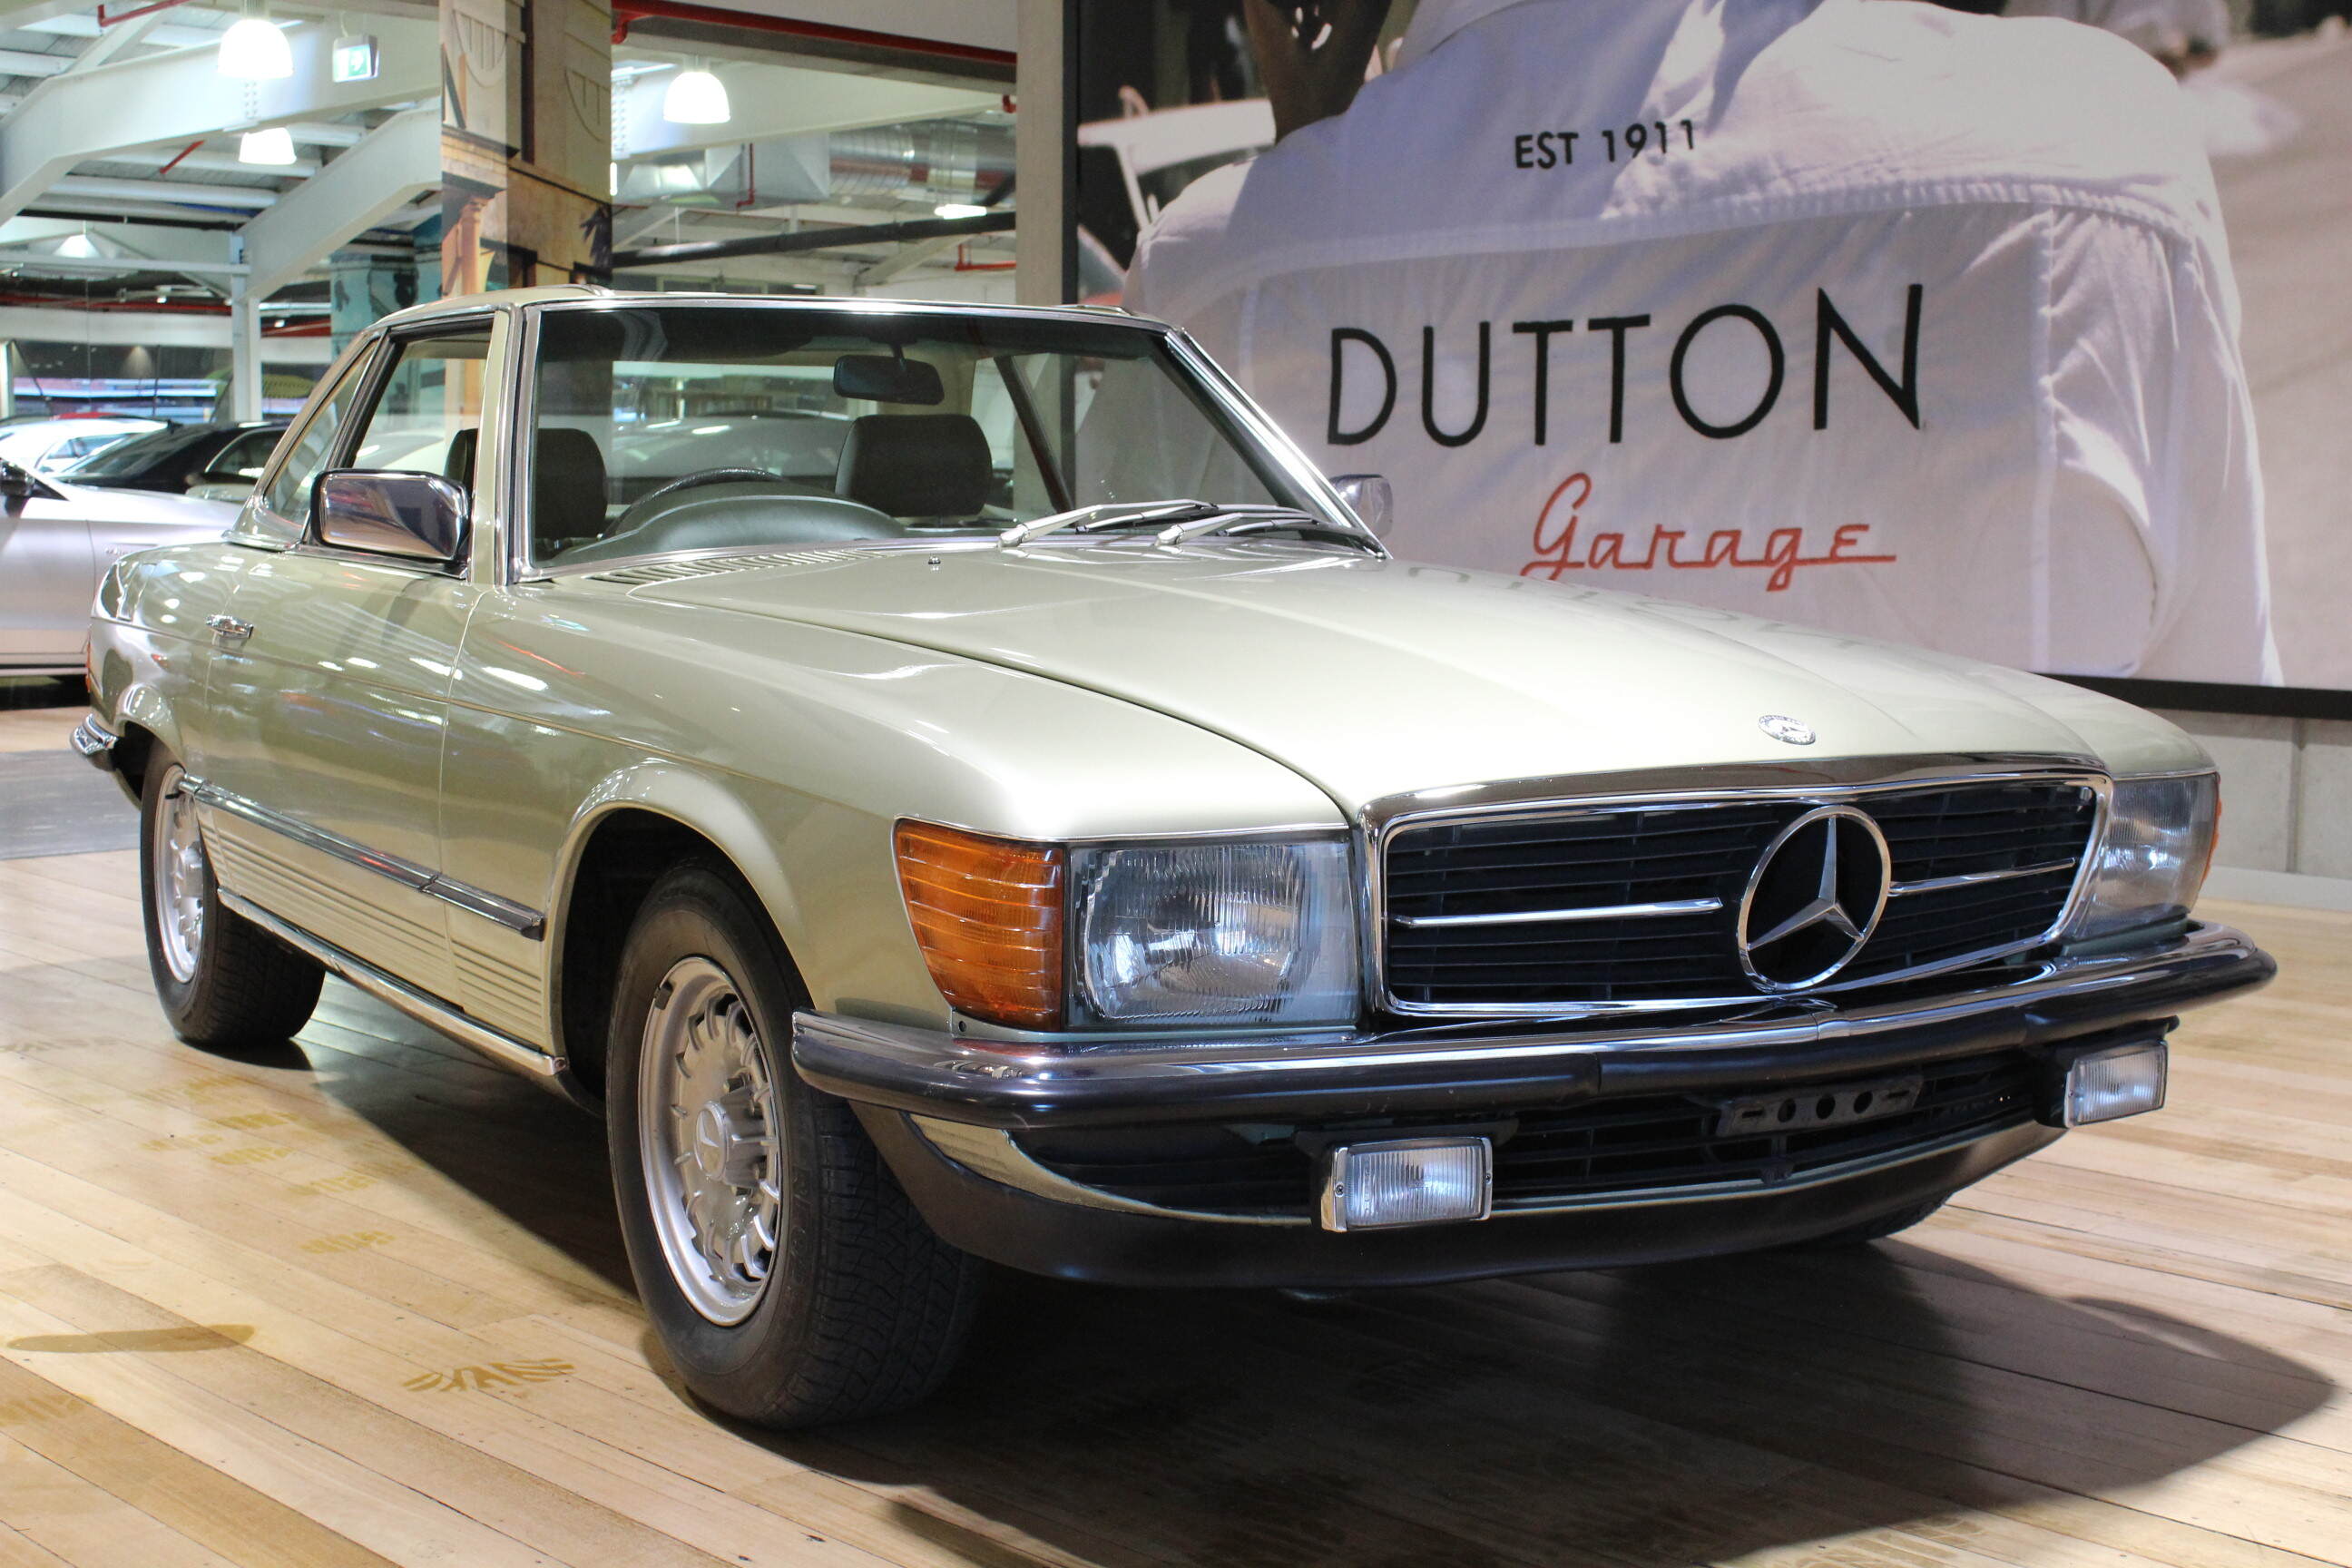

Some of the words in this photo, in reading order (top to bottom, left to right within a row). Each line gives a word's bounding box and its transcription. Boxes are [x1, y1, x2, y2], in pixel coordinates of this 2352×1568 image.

[1514, 131, 1579, 170] EST
[1601, 119, 1694, 162] 1911
[1328, 283, 1924, 447] DUTTON
[1520, 472, 1897, 593] Garage
